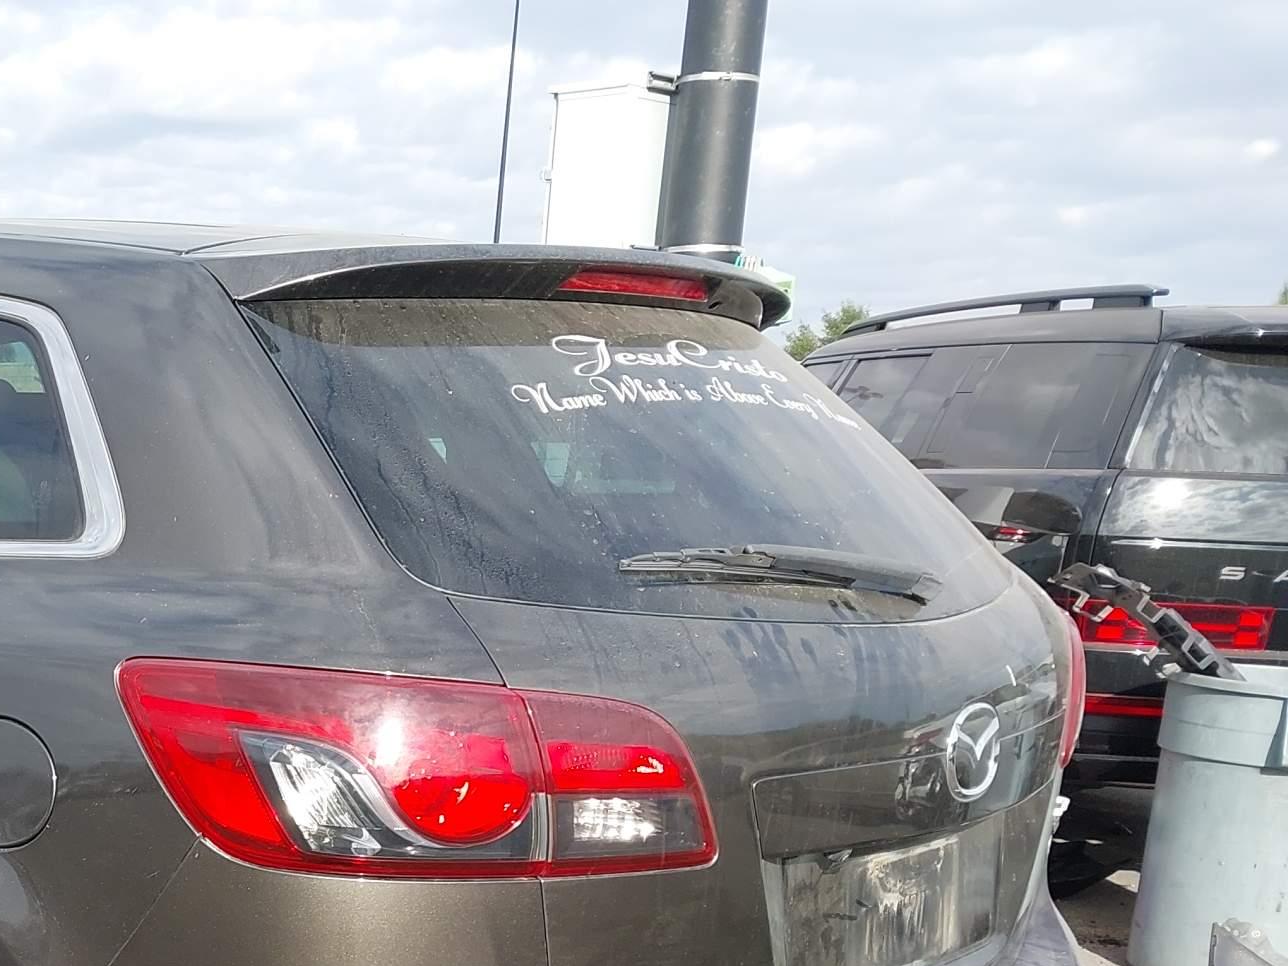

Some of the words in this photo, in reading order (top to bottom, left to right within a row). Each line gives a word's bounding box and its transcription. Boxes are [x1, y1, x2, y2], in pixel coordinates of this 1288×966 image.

[552, 334, 788, 382] JesuCristo
[511, 381, 607, 414] Name
[588, 374, 682, 403] Which
[679, 383, 703, 401] is
